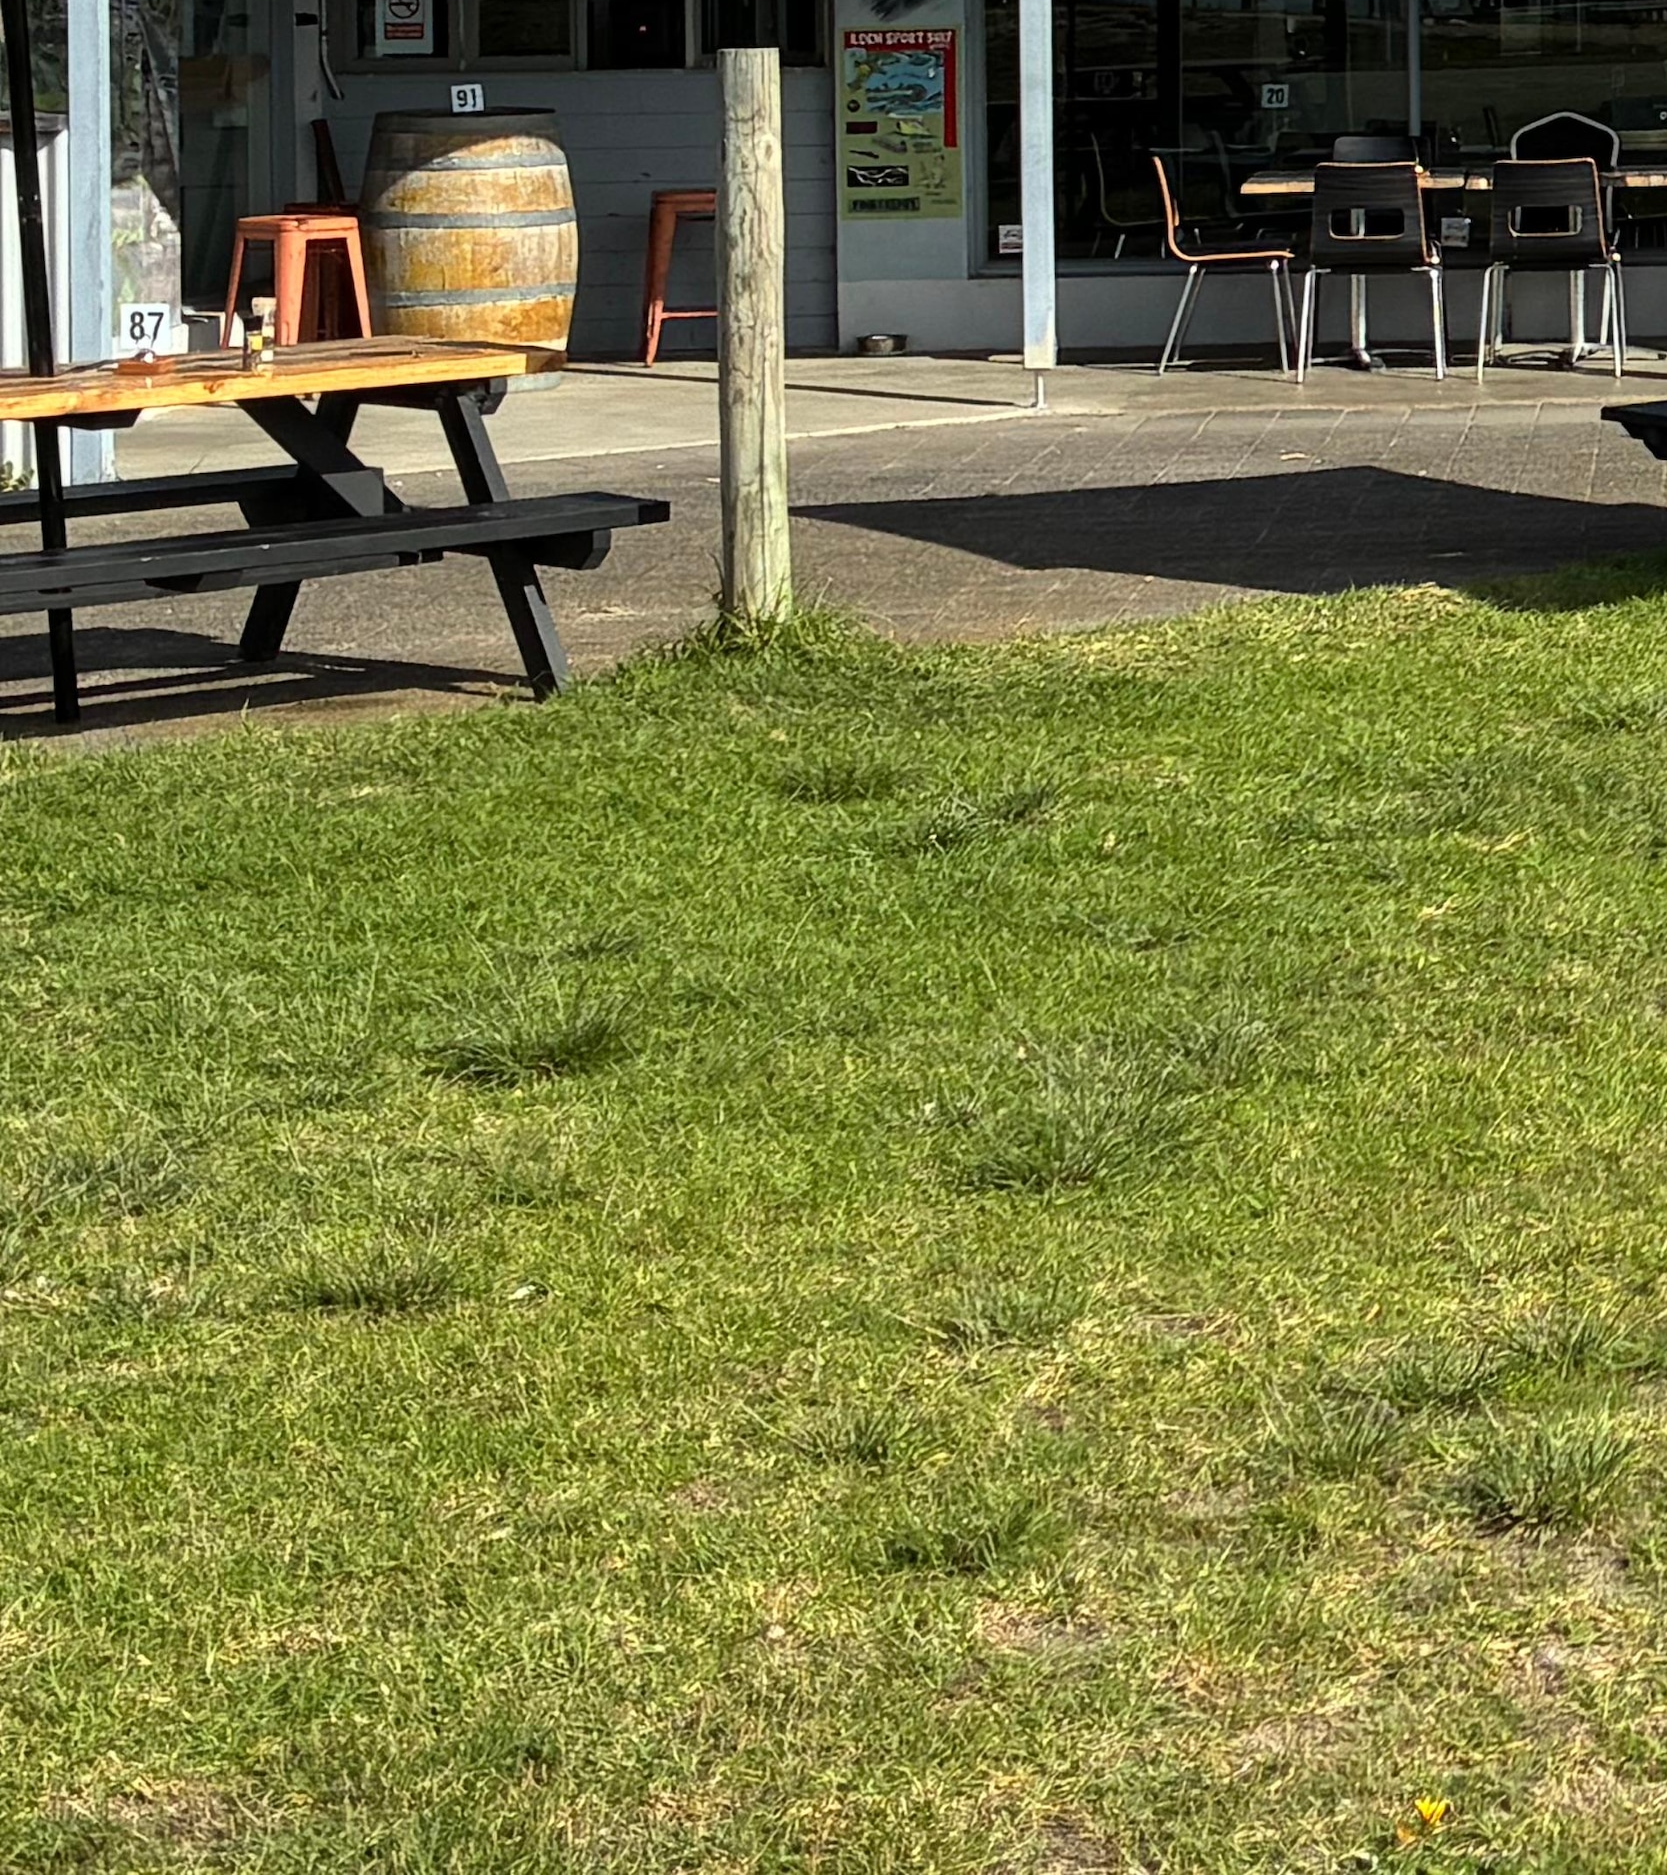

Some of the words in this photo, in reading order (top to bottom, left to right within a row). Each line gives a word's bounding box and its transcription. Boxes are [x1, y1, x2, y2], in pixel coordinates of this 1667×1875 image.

[456, 88, 477, 108] 91
[1266, 88, 1285, 104] 20
[129, 311, 165, 342] 87
